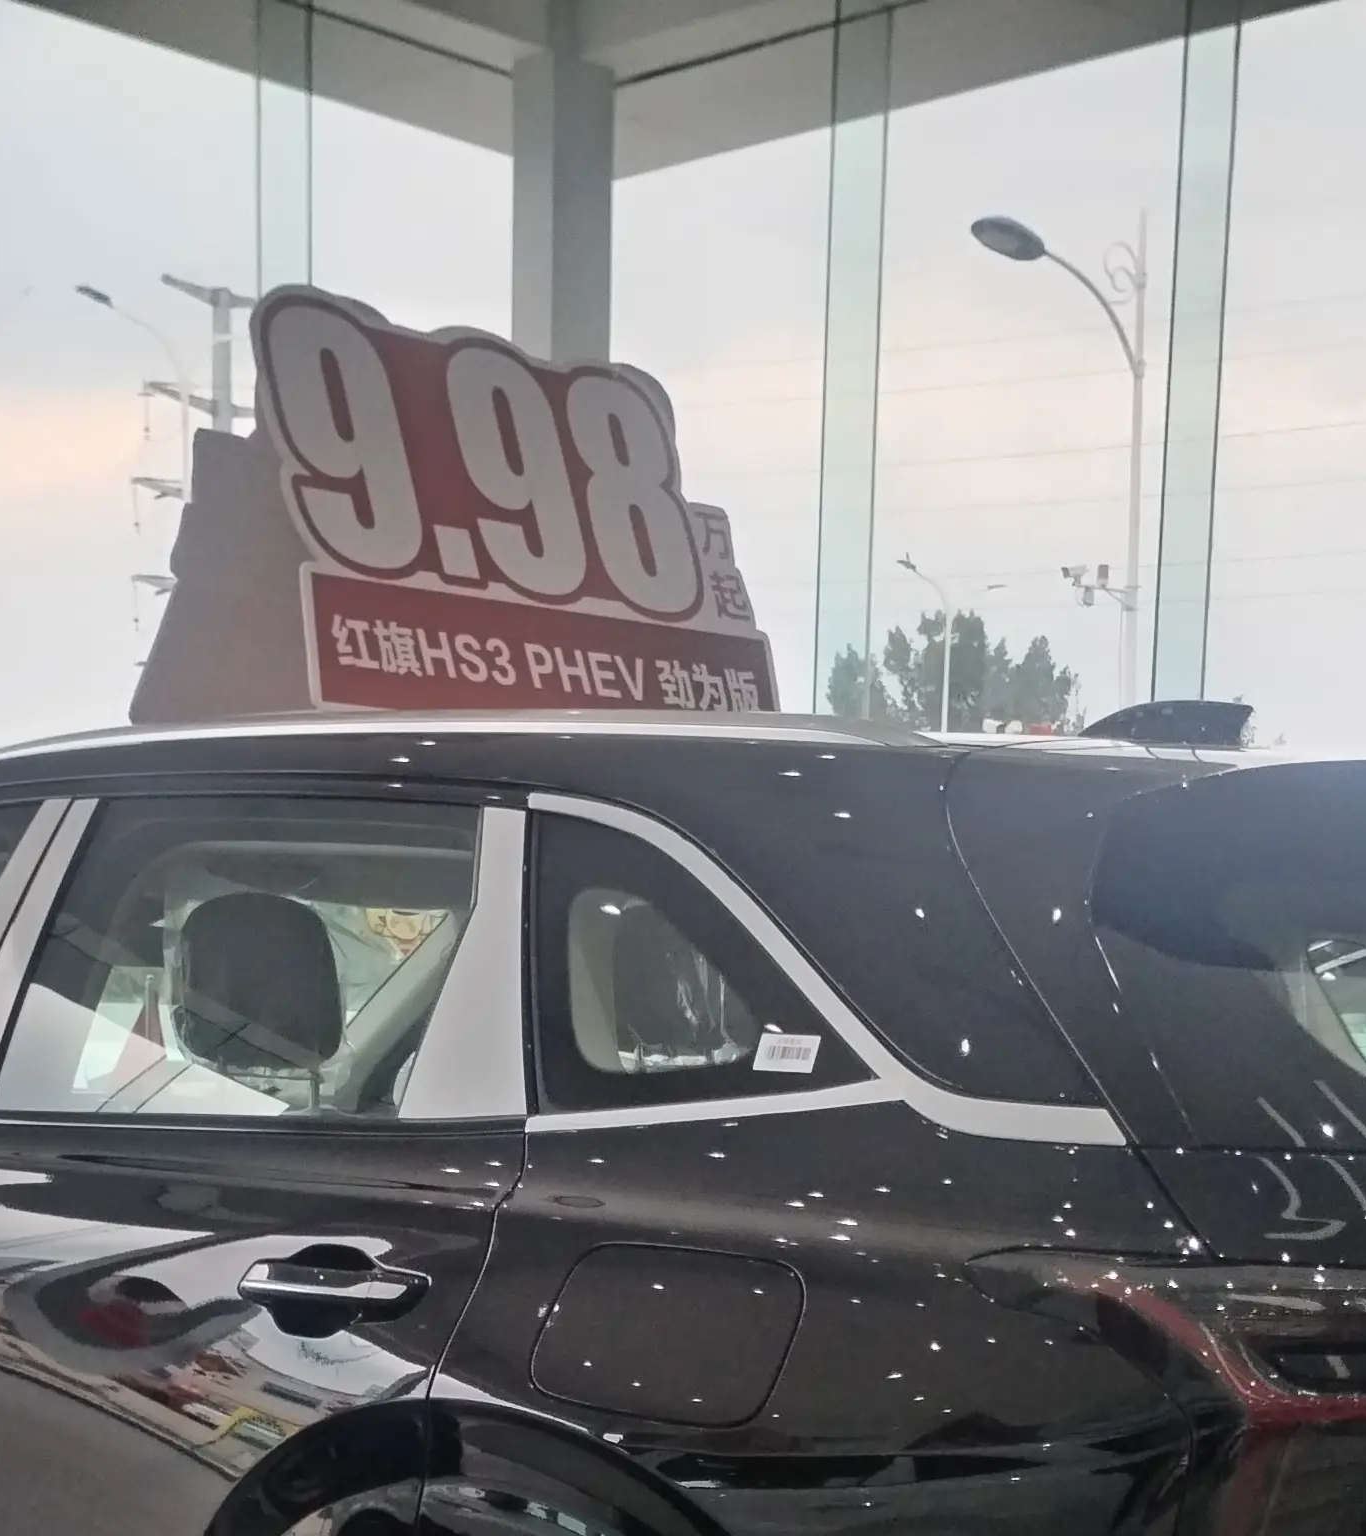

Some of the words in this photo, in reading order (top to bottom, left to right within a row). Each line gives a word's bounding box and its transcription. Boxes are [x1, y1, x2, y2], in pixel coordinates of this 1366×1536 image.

[264, 302, 700, 618] 9.98
[694, 511, 750, 621] 万起
[332, 614, 516, 687] 红旗HS3
[524, 643, 644, 702] PHEV
[655, 659, 759, 713] 劲为版
